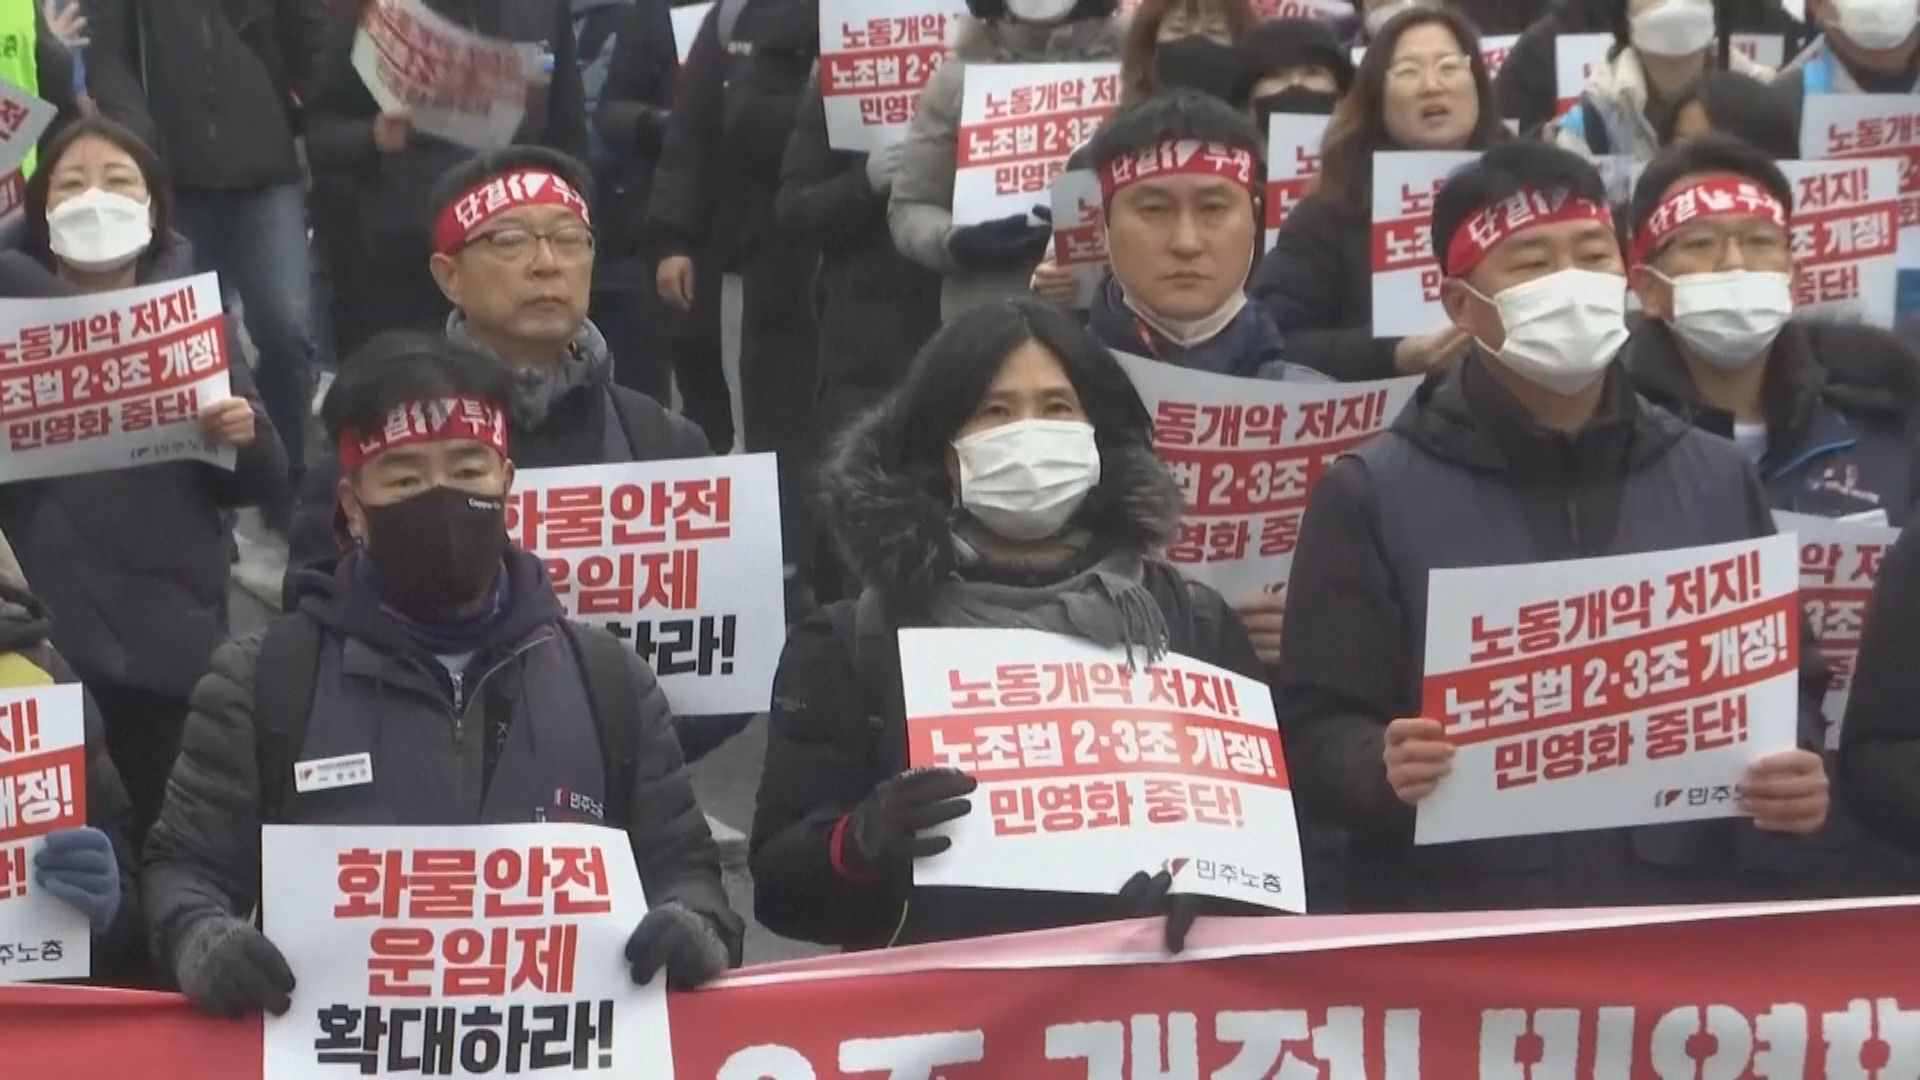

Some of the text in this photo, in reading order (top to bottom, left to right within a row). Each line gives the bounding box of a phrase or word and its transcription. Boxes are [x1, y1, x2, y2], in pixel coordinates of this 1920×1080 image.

[841, 13, 947, 49] 노동개악
[830, 51, 949, 89] 노조법 2·3
[985, 74, 1123, 119] 노동개악 저
[967, 122, 1040, 162] 노조법
[454, 176, 511, 230] 단결
[1799, 167, 1869, 210] 저지!
[1467, 190, 1536, 249] 단결
[1821, 208, 1890, 256] 개정!
[129, 284, 199, 338] 저지!
[71, 351, 152, 399] 2·3조
[158, 327, 221, 382] 개정!
[9, 386, 199, 451] 민영화 중단!
[1295, 388, 1389, 440] 저지!
[1208, 456, 1310, 506] 2·3조
[1470, 549, 1762, 664] 노동개악 저지!
[948, 662, 1240, 717] 노동개악 저지!
[1444, 663, 1573, 737] 노조법
[1583, 640, 1691, 708] 2·3조
[1700, 610, 1788, 682] 개정!
[930, 718, 1278, 779] 노조법 2·3조 개정!
[1494, 693, 1749, 791] 민영화 중단!
[988, 779, 1245, 838] 민영화 중단!
[333, 846, 612, 919] 화물안전
[1196, 858, 1282, 894] 민주노총
[367, 923, 579, 998] 운임제
[313, 999, 615, 1077] 확대하라!
